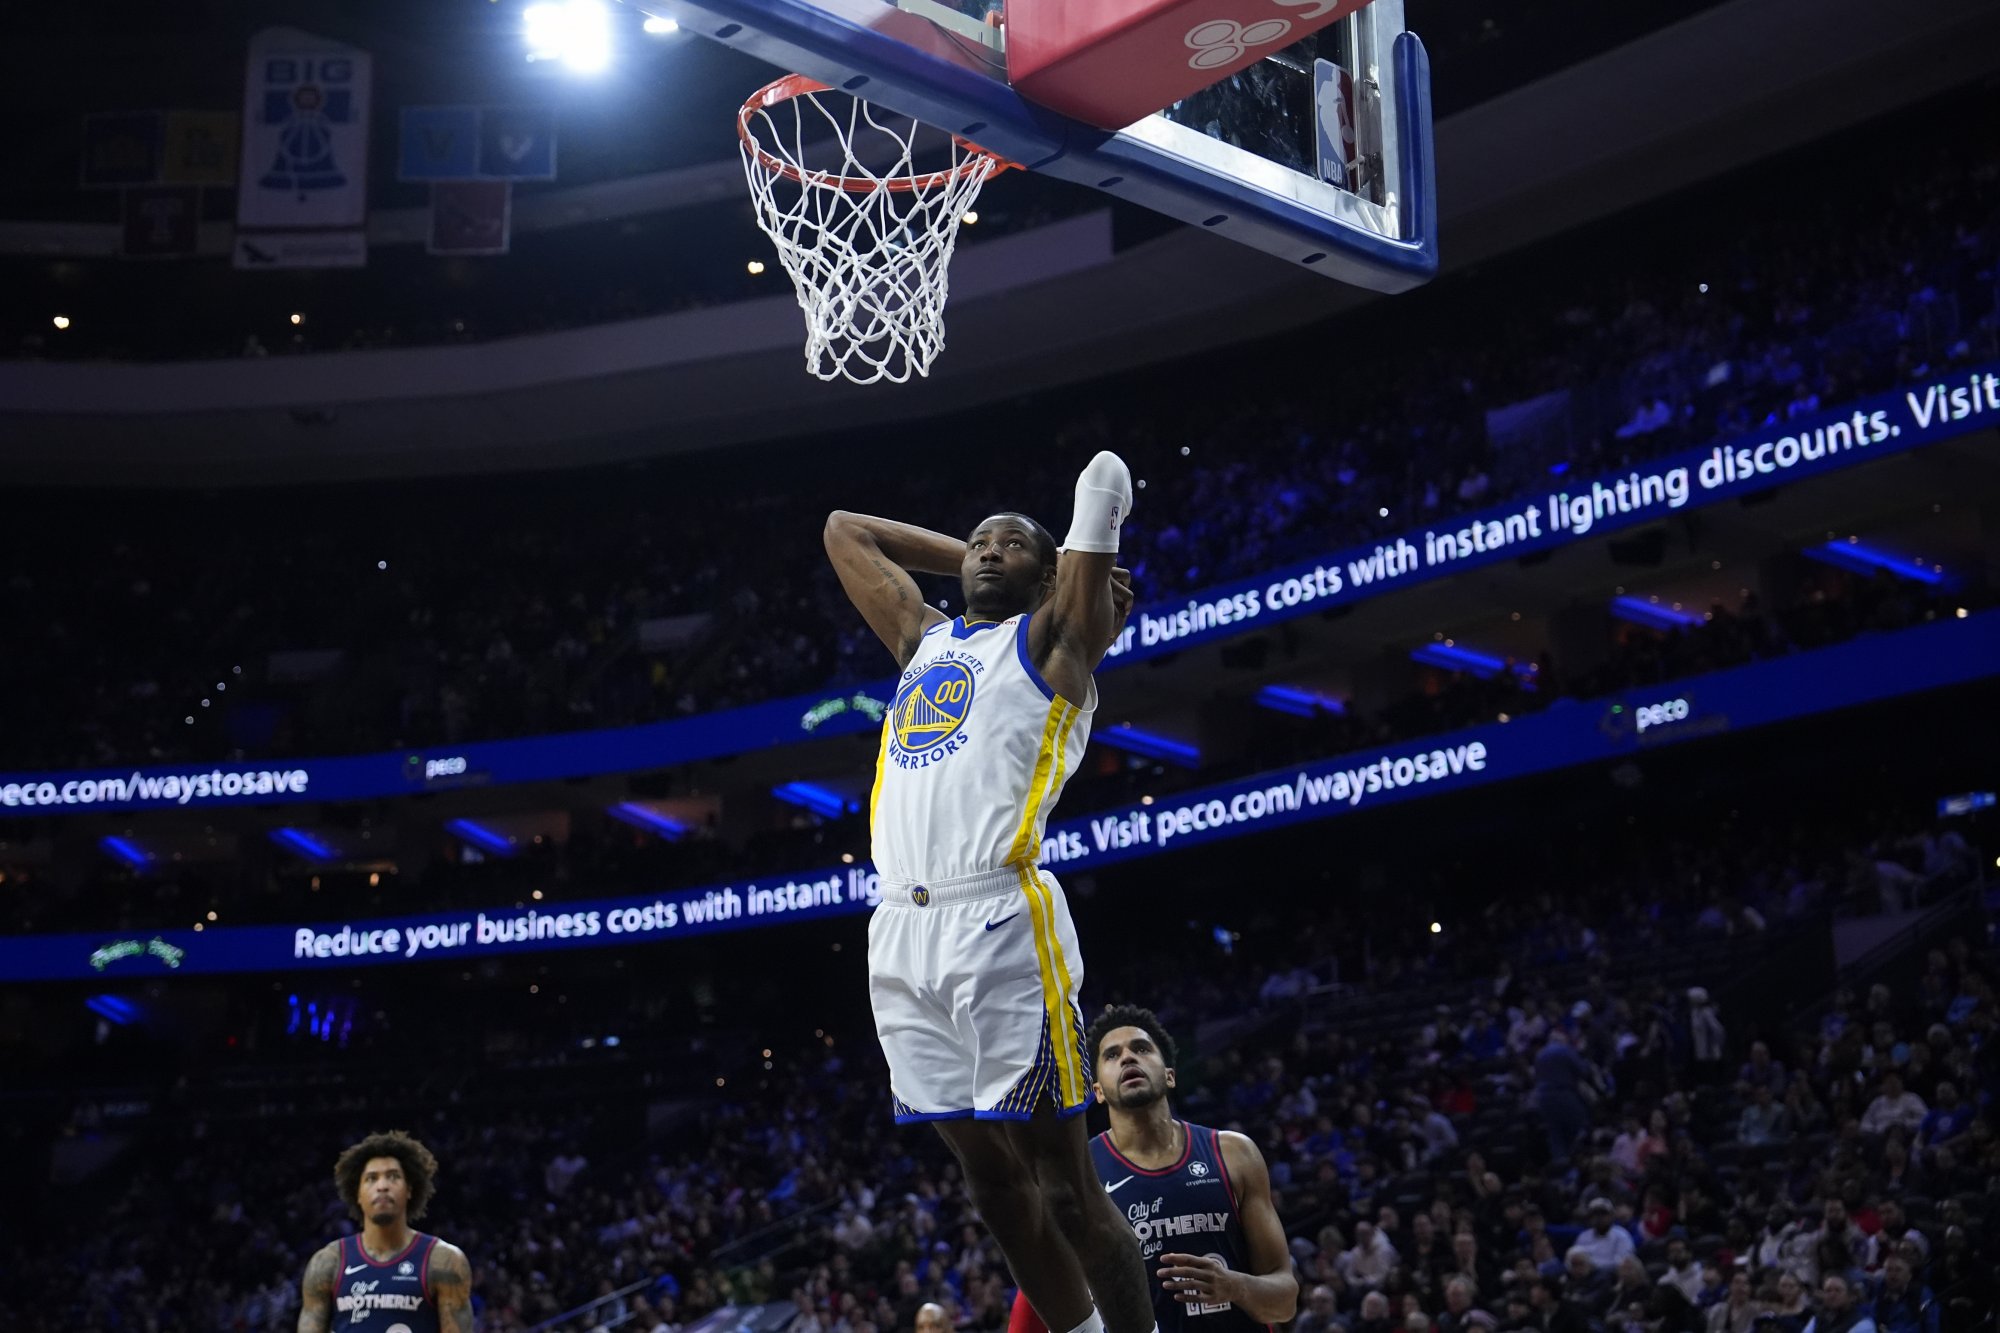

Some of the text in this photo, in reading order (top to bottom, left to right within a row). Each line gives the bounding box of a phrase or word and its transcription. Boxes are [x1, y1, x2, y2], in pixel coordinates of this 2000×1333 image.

[265, 59, 352, 84] BIG
[1323, 158, 1343, 184] NBA
[1107, 373, 2000, 656] ur business costs with instant lighting discounts. Visit
[903, 650, 985, 681] GOLDEN STATE
[934, 679, 967, 705] 00
[1635, 698, 1690, 734] peco
[888, 731, 969, 769] WARRIORS
[0, 769, 309, 806] eco.com/waystosave
[294, 741, 1487, 958] Reduce your business costs with instant lig nts. Visit peco.com/waystosave
[912, 890, 929, 904] W
[1185, 1177, 1220, 1187] crypto.com
[1128, 1197, 1164, 1225] City of
[1133, 1213, 1229, 1240] OTHERLY
[336, 1293, 424, 1312] BROTHERLY
